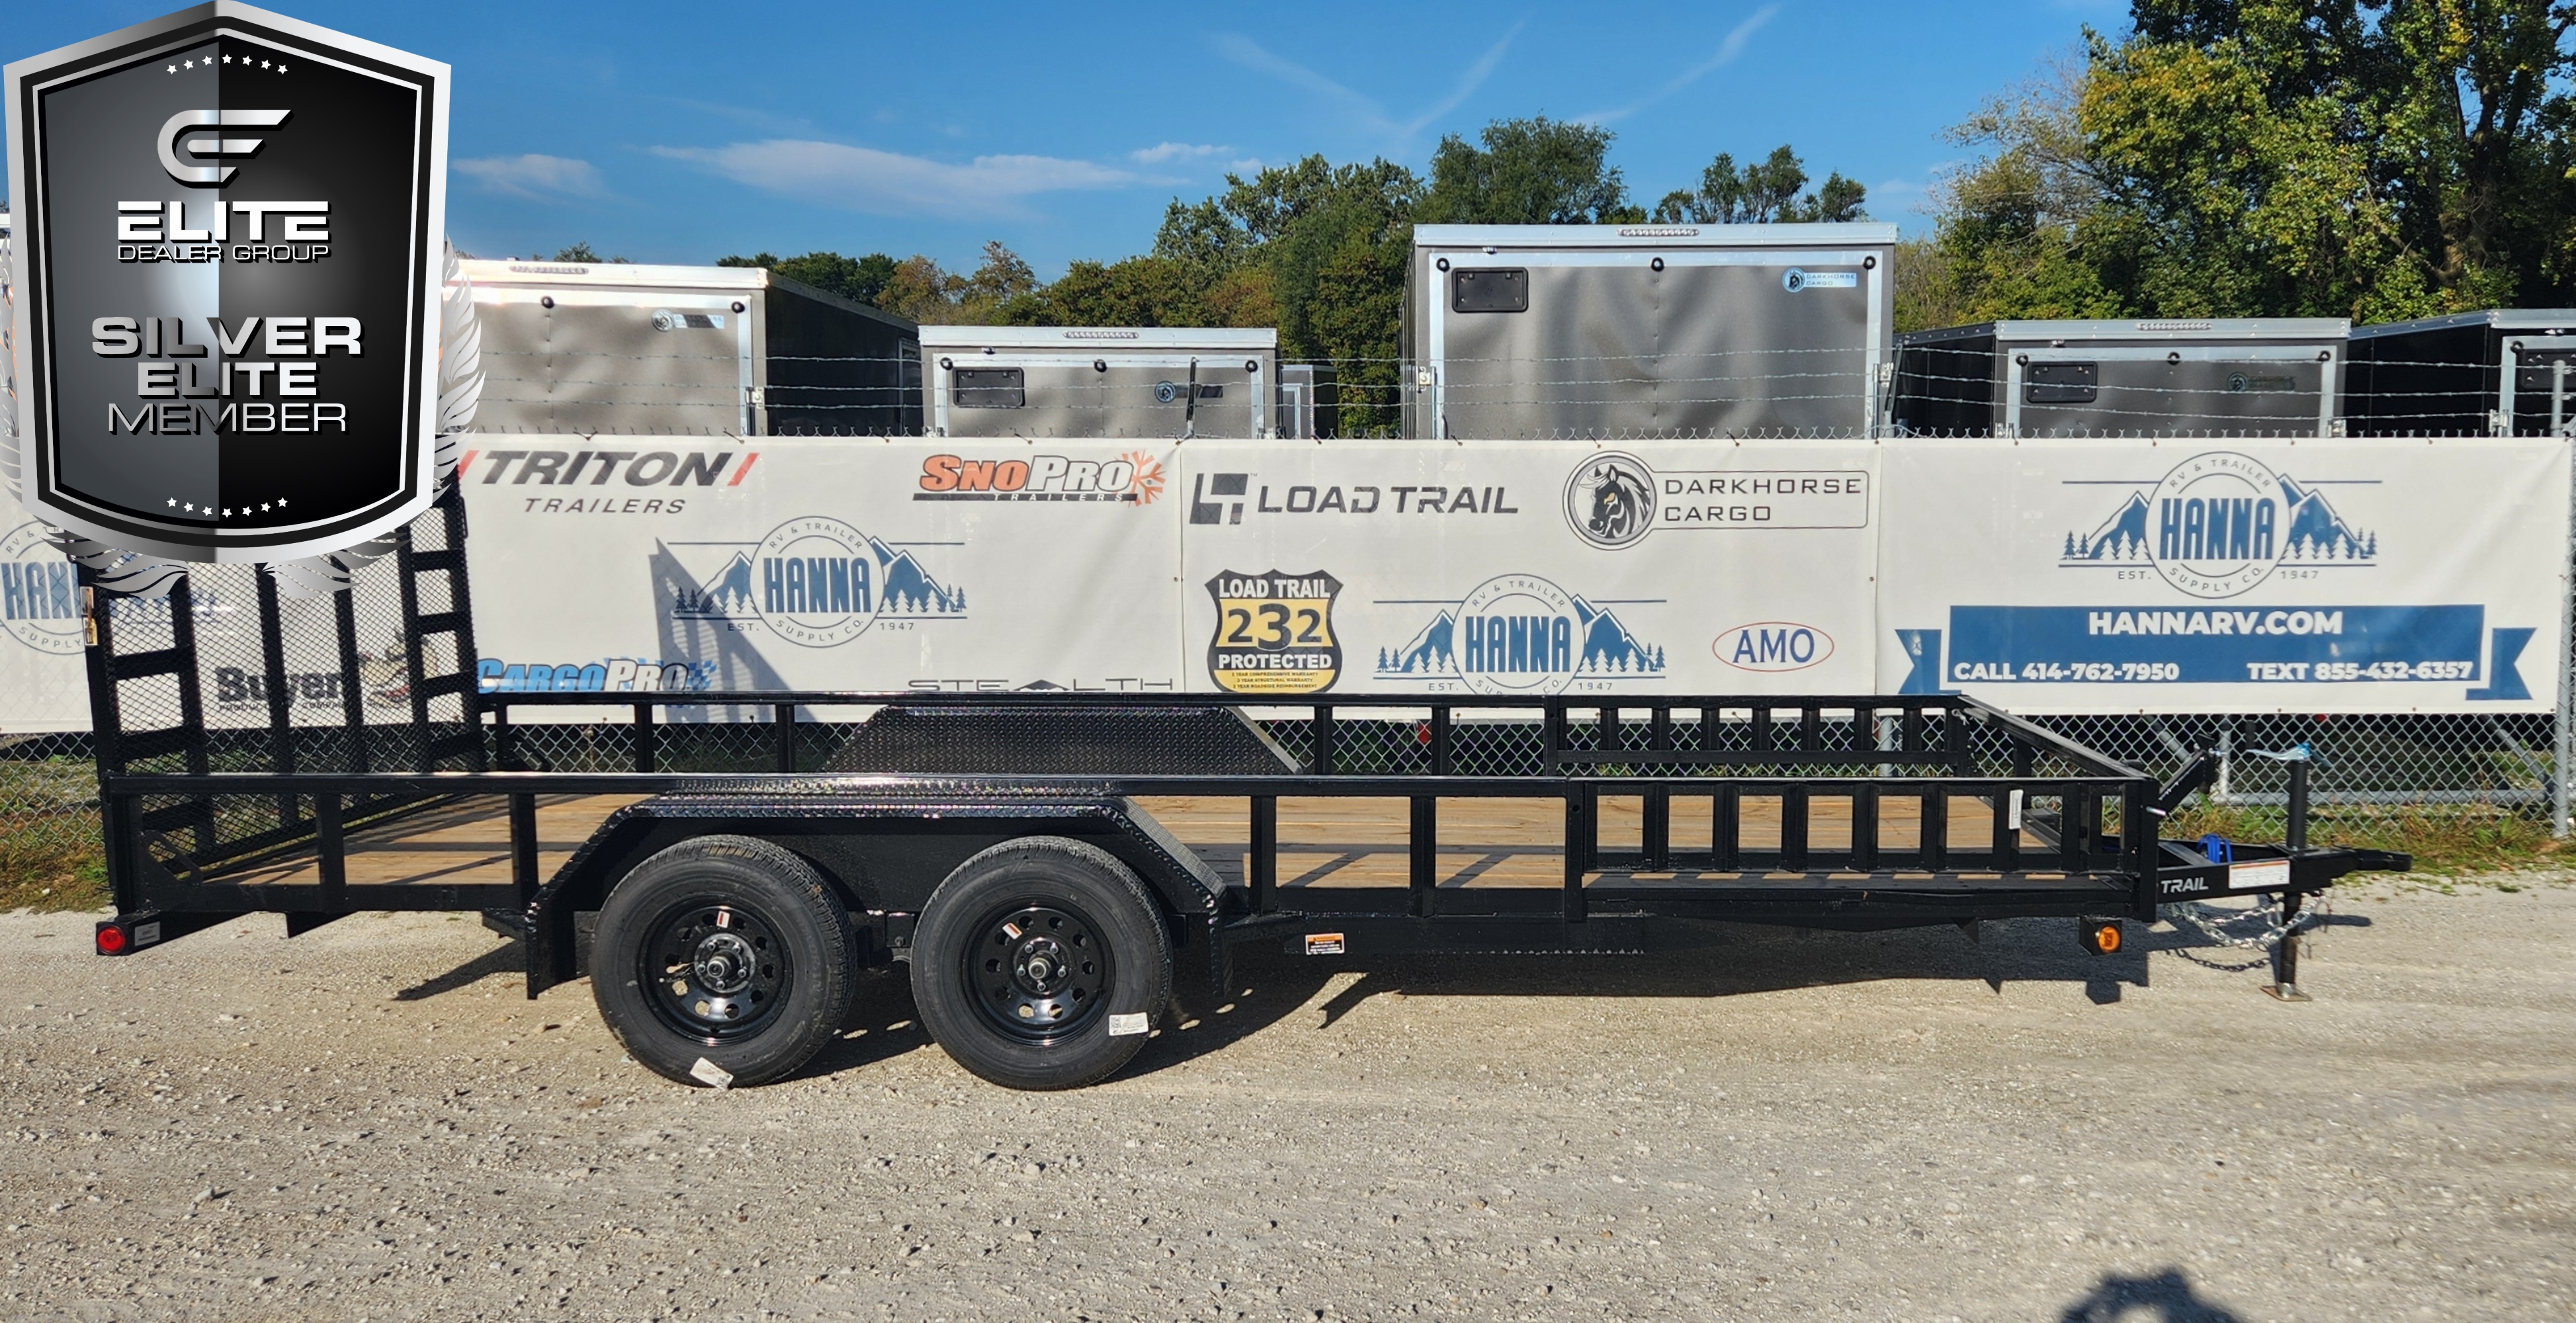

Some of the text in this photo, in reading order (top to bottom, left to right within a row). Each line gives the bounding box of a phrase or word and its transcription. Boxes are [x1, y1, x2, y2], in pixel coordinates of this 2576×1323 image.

[482, 450, 733, 486] TRITON
[2169, 472, 2186, 488] RV
[2211, 459, 2270, 488] TRAILER
[993, 493, 1123, 501] TRAILERS
[1664, 479, 1862, 495] DARKHORSE
[525, 498, 686, 514] TRAILERS
[1258, 486, 1519, 514] LOAD TRAIL
[1664, 505, 1772, 522] CARGO
[769, 534, 783, 549] RV
[805, 523, 863, 549] TRAILER
[2159, 497, 2276, 560] HANNA
[6, 538, 20, 554] RV
[763, 557, 872, 613] HANNA
[2118, 571, 2151, 579] EST.
[2169, 567, 2231, 591] SUPPLY
[1219, 579, 1330, 599] LOAD TRAIL
[1472, 592, 1486, 607] RV
[1508, 581, 1565, 607] TRAILER
[776, 619, 835, 642] SUPPLY
[880, 622, 914, 631] 1947
[1227, 603, 1322, 650] 232
[2088, 611, 2342, 636] HANNARV.COM
[19, 626, 81, 648] SUPPLY
[1465, 616, 1571, 673] HANNA
[1732, 628, 1815, 663] AMO
[1219, 654, 1332, 669] PROTECTED
[1953, 662, 2180, 681] CALL 414-762-7950
[2247, 662, 2473, 680] TEXT 855-432-6357
[1578, 682, 1613, 691] 1947
[2161, 877, 2210, 894] TRAIL
